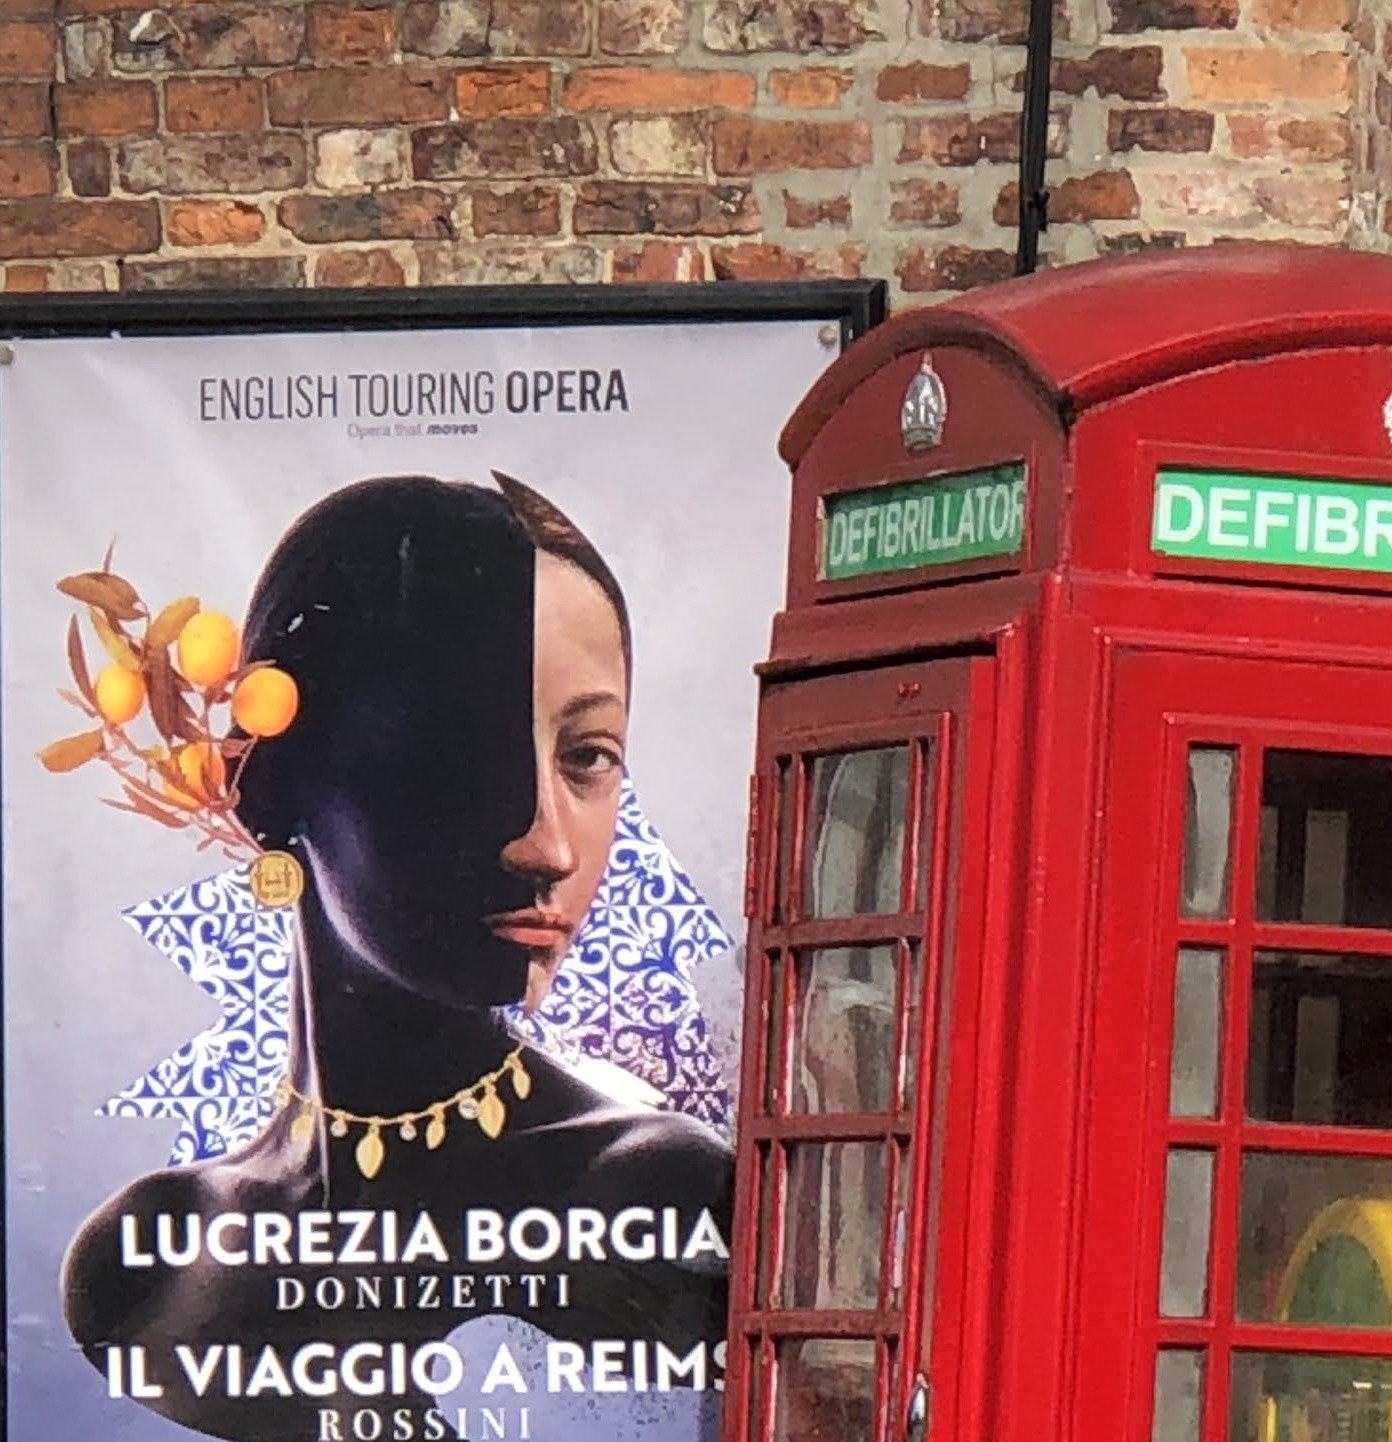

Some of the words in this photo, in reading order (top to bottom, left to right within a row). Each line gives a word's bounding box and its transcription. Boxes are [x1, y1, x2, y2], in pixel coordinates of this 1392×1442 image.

[199, 374, 338, 421] ENGLISH
[347, 371, 494, 418] TOURING
[506, 369, 630, 413] OPERA
[347, 423, 391, 440] Opera
[120, 1210, 448, 1268] LUCREZIA
[467, 1206, 730, 1261] BORGIA
[276, 1274, 570, 1311] DONIZETTI
[106, 1346, 163, 1398] IL
[175, 1341, 463, 1397] VIAGGIO
[481, 1343, 528, 1394] A
[318, 1406, 531, 1442] ROSSINI
